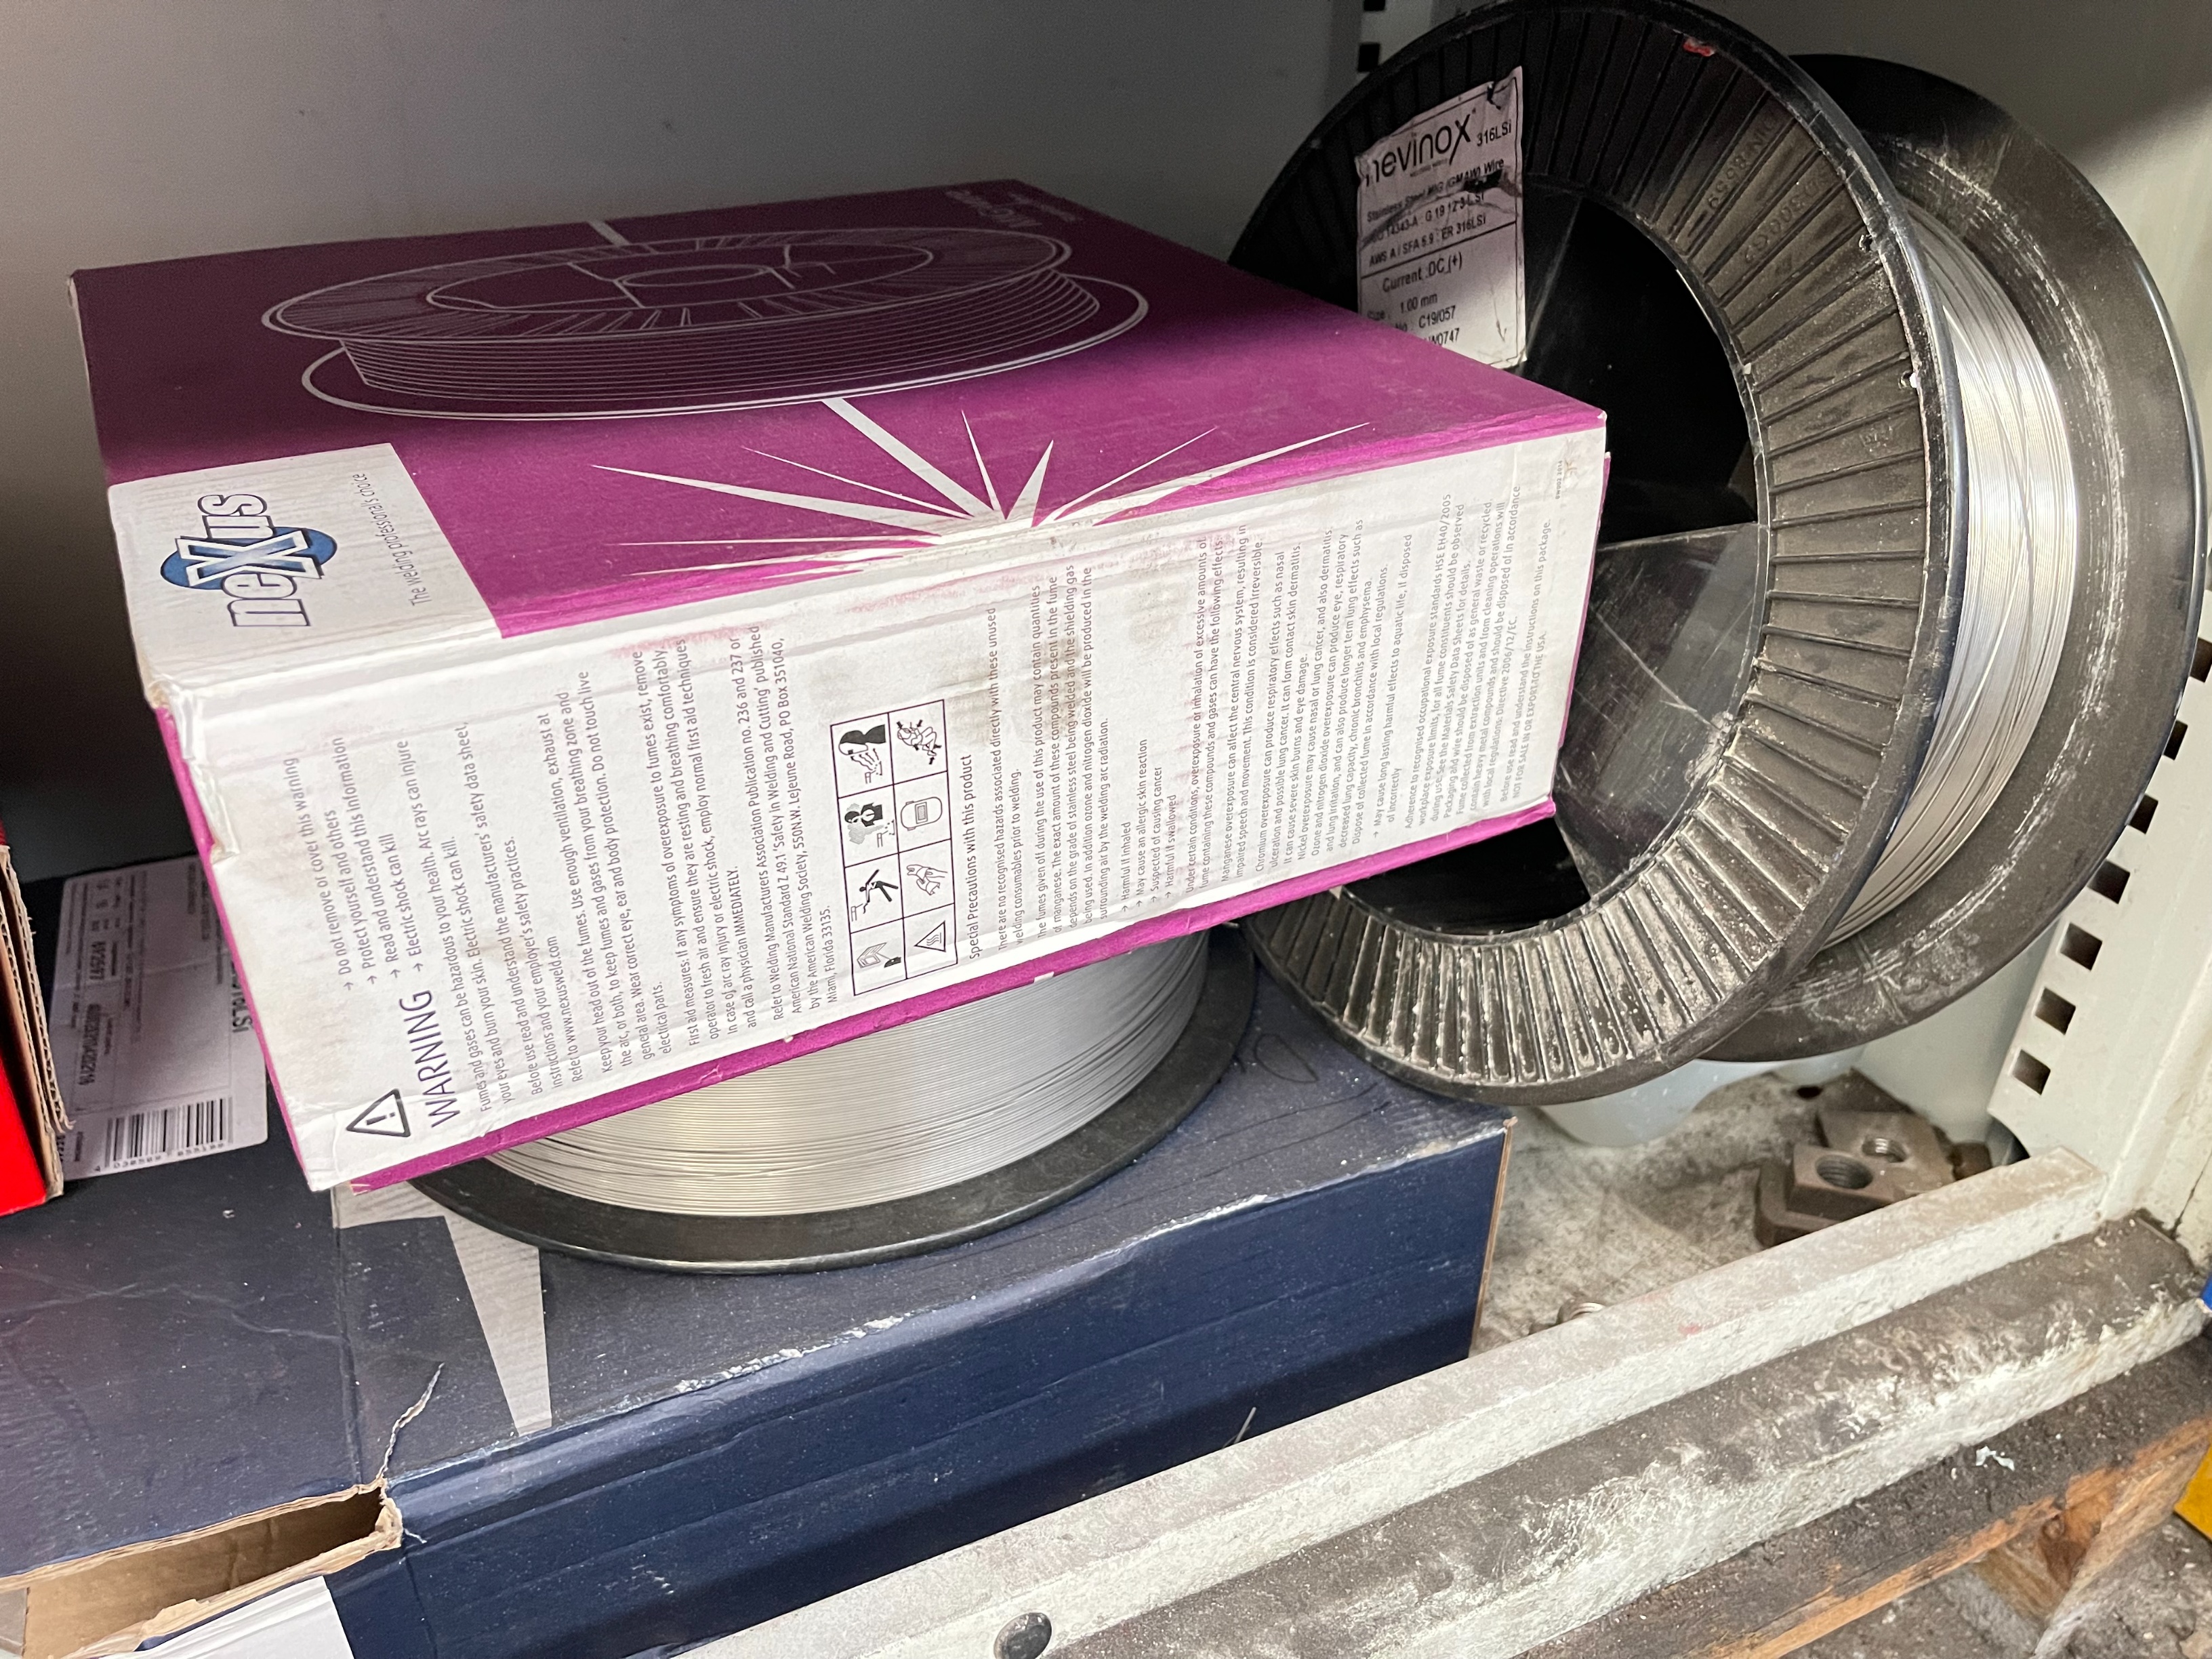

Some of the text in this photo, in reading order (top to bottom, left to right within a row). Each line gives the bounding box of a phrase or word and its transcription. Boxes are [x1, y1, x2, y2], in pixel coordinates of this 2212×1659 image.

[1477, 121, 1511, 147] 316LSi
[1483, 158, 1504, 173] Wire
[1425, 209, 1433, 222] G
[1369, 249, 1387, 267] AWS
[1456, 214, 1487, 234] 316LSi
[1382, 267, 1422, 293] Current
[1420, 293, 1437, 308] mm
[1418, 305, 1456, 329] C19/057
[351, 473, 375, 497] choice
[392, 550, 422, 586] welding
[1434, 552, 1445, 571] HSE
[408, 586, 432, 607] The
[1429, 573, 1442, 620] standards
[744, 625, 769, 683] published
[1425, 621, 1437, 664] exposure
[1418, 666, 1431, 724] occupational
[758, 731, 774, 753] and
[1412, 724, 1425, 773] recognised
[763, 754, 779, 800] Welding
[1410, 773, 1418, 783] to
[768, 801, 781, 813] in
[1133, 739, 1149, 897] May cause an allergic skin reaction
[1404, 784, 1417, 828] Adherence
[331, 737, 398, 962] Read and understand this information
[632, 649, 700, 1046] First aid measures: If any symptoms of overexposure to fumes exist, remove
[728, 637, 784, 1020] Refer to Welding Manufacturers Association Publication no. 236 and 237 or
[1120, 821, 1131, 857] inhaled
[1149, 766, 1164, 891] Suspected of causing cancer
[282, 757, 352, 975] Do not remove or cover this warning
[775, 853, 787, 873] 49.1
[959, 754, 982, 959] Special Precautions with this product
[323, 809, 376, 969] Protect yourself and others
[377, 833, 422, 956] Electric shock can kill
[1120, 865, 1130, 901] Harmful
[396, 741, 492, 1112] Fumes and gases can be hazardous to your health. Arc rays can injure
[777, 884, 794, 928] Standard
[781, 929, 798, 970] National
[819, 905, 841, 1003] Miami, Florida 33135.
[546, 936, 587, 1082] Refer to www.nexusweld.com
[788, 970, 802, 1013] American
[398, 989, 460, 1128] WARNING
